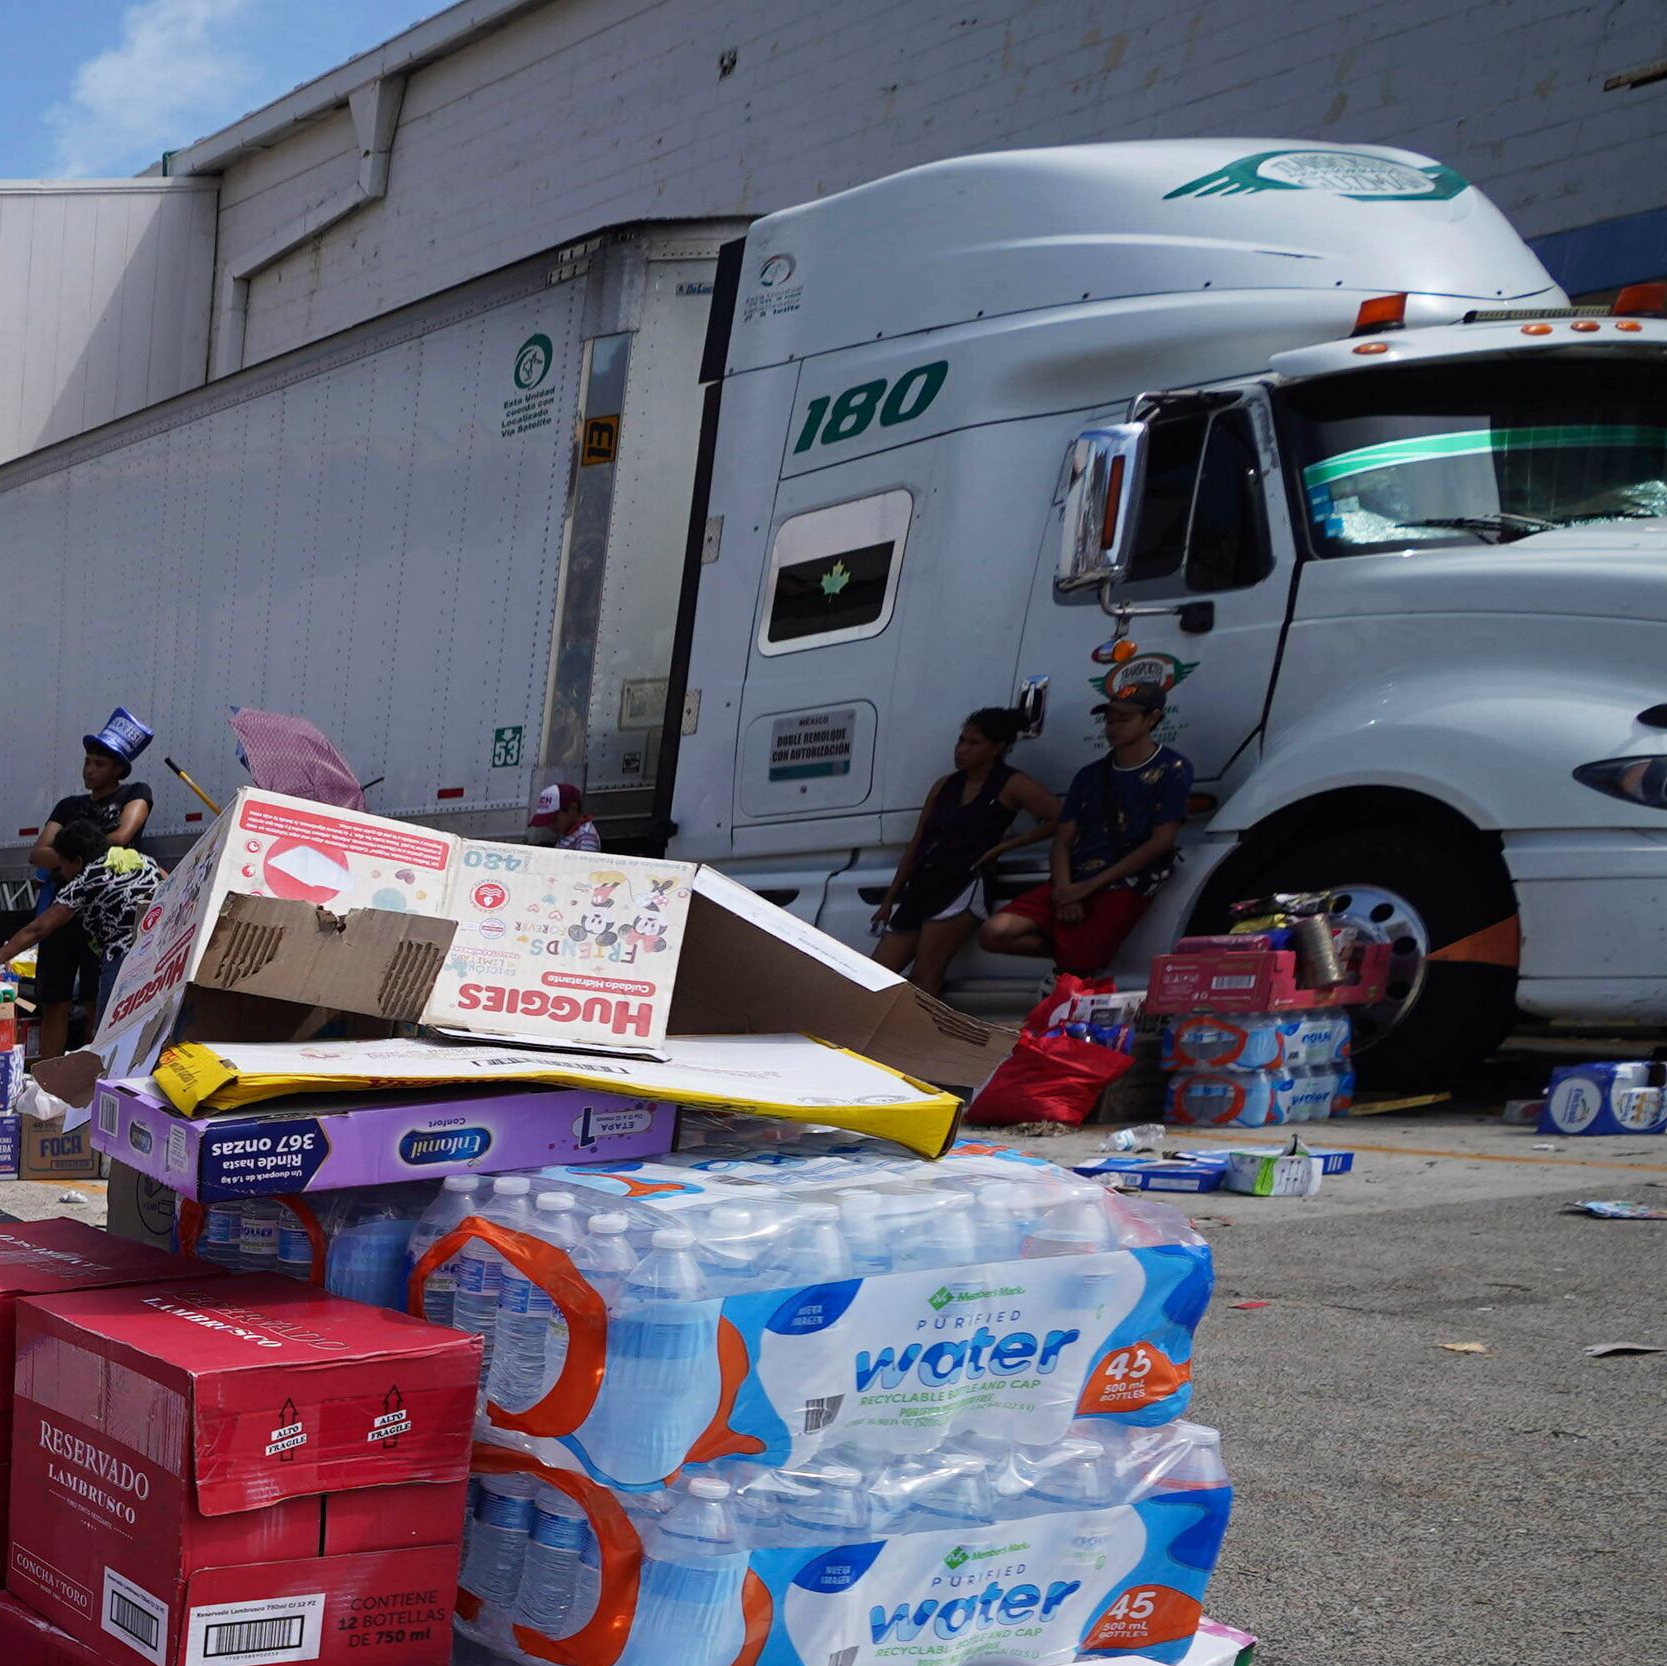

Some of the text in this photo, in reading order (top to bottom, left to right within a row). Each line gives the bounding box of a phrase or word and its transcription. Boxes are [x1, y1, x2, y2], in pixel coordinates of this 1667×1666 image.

[503, 387, 555, 409] Esta Unidad
[793, 361, 949, 455] 180
[506, 401, 536, 418] cuenta
[587, 421, 618, 460] 13
[777, 727, 846, 749] DOBLE REMOLQUE
[494, 741, 520, 768] 53
[772, 740, 851, 763] CON AUTORIZACIÓN
[463, 850, 523, 872] 480
[547, 974, 650, 993] Cuidado Hidratante
[457, 983, 653, 1037] HUGGIES
[40, 1135, 82, 1158] FOCA
[211, 1132, 315, 1157] 367 onzas
[222, 1153, 302, 1169] Rinde hasta
[917, 1310, 1022, 1331] PURIFIED
[855, 1327, 1081, 1393] water
[1104, 1349, 1152, 1381] 45
[1099, 1389, 1146, 1402] BOTTLES
[379, 1412, 406, 1426] ALTO
[276, 1425, 300, 1438] ALTO
[369, 1421, 412, 1441] FRAGILE
[267, 1434, 306, 1455] FRAGILE
[38, 1419, 149, 1501] RESERVADO
[47, 1463, 136, 1525] LAMBRUSCO
[932, 1563, 1027, 1590] PURIFIED
[351, 1590, 438, 1611] CONTIENE
[1108, 1590, 1157, 1621] 45
[338, 1608, 446, 1630] 12 BOTELLAS
[869, 1578, 1083, 1647] water
[348, 1628, 432, 1647] DE 750 ml
